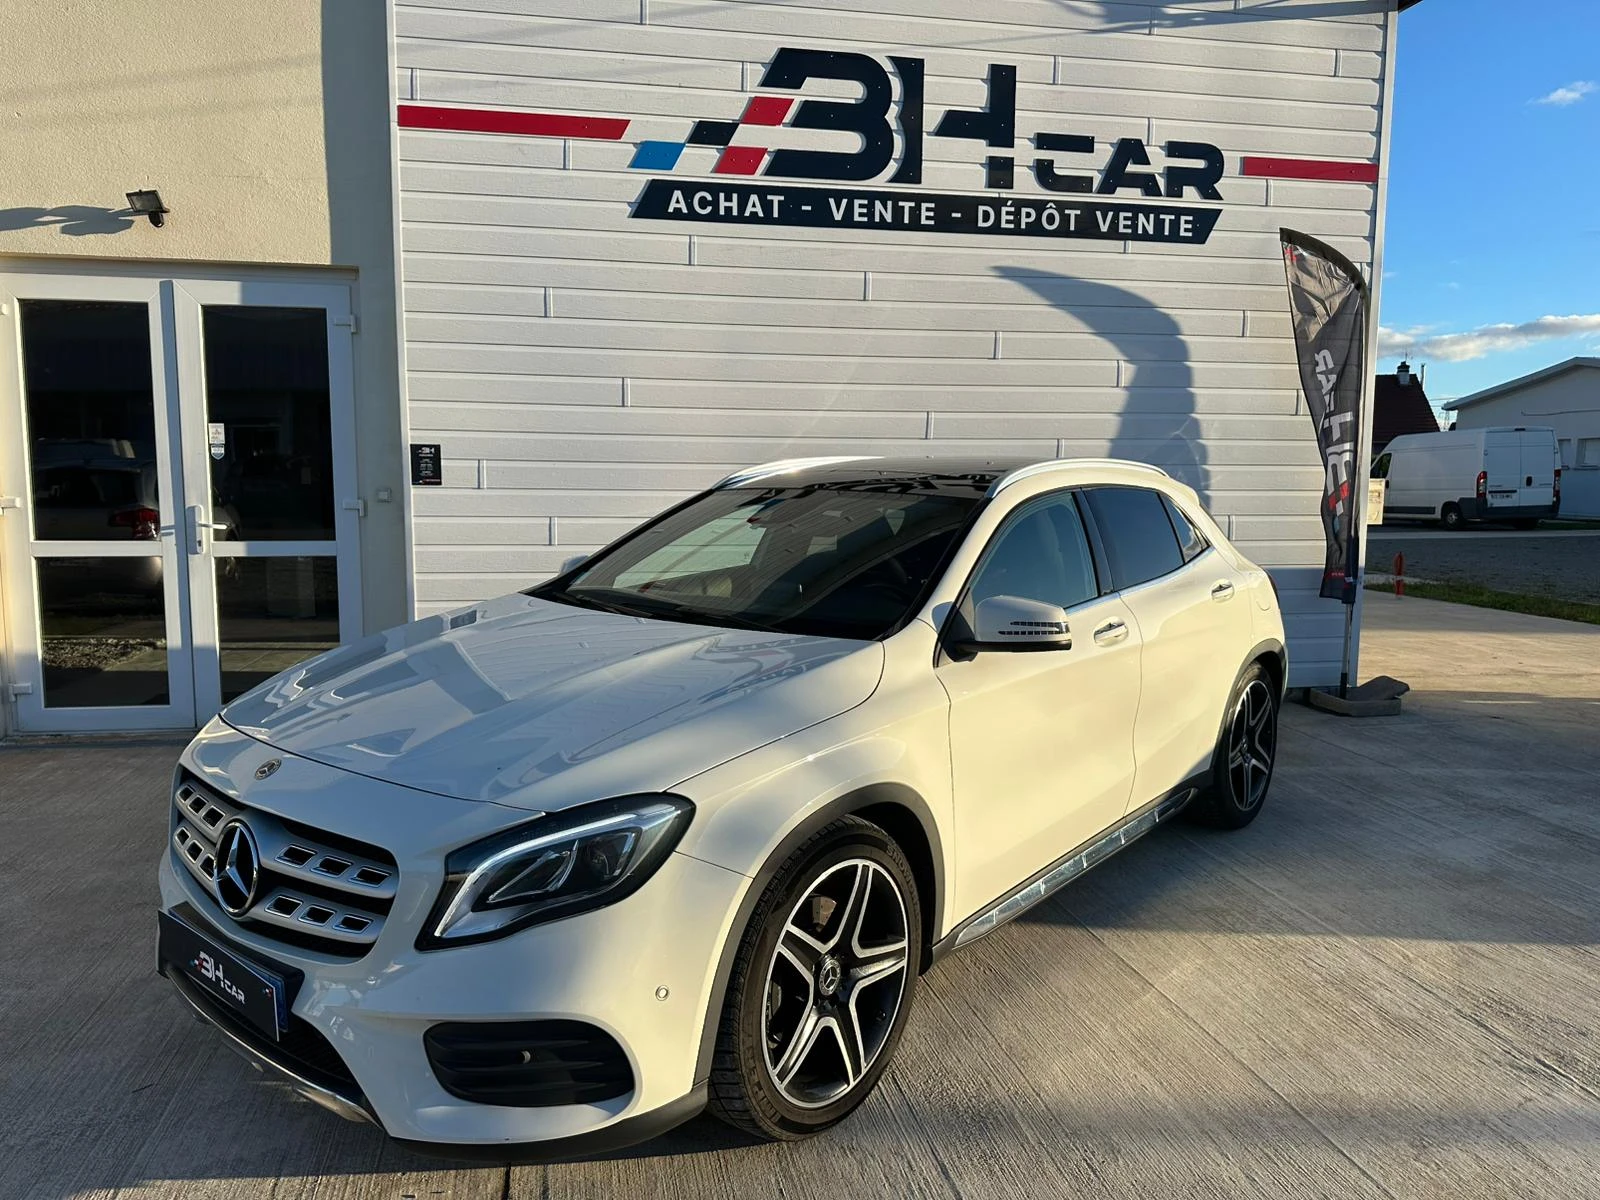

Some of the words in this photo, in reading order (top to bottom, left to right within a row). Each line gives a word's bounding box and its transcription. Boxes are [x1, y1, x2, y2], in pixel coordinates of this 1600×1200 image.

[757, 47, 1016, 189] BH
[1036, 133, 1224, 200] CAR
[667, 190, 785, 218] ACHAT
[828, 197, 936, 225] VENTE
[977, 200, 1081, 231] DÉPÔT
[1095, 210, 1194, 237] VENTE
